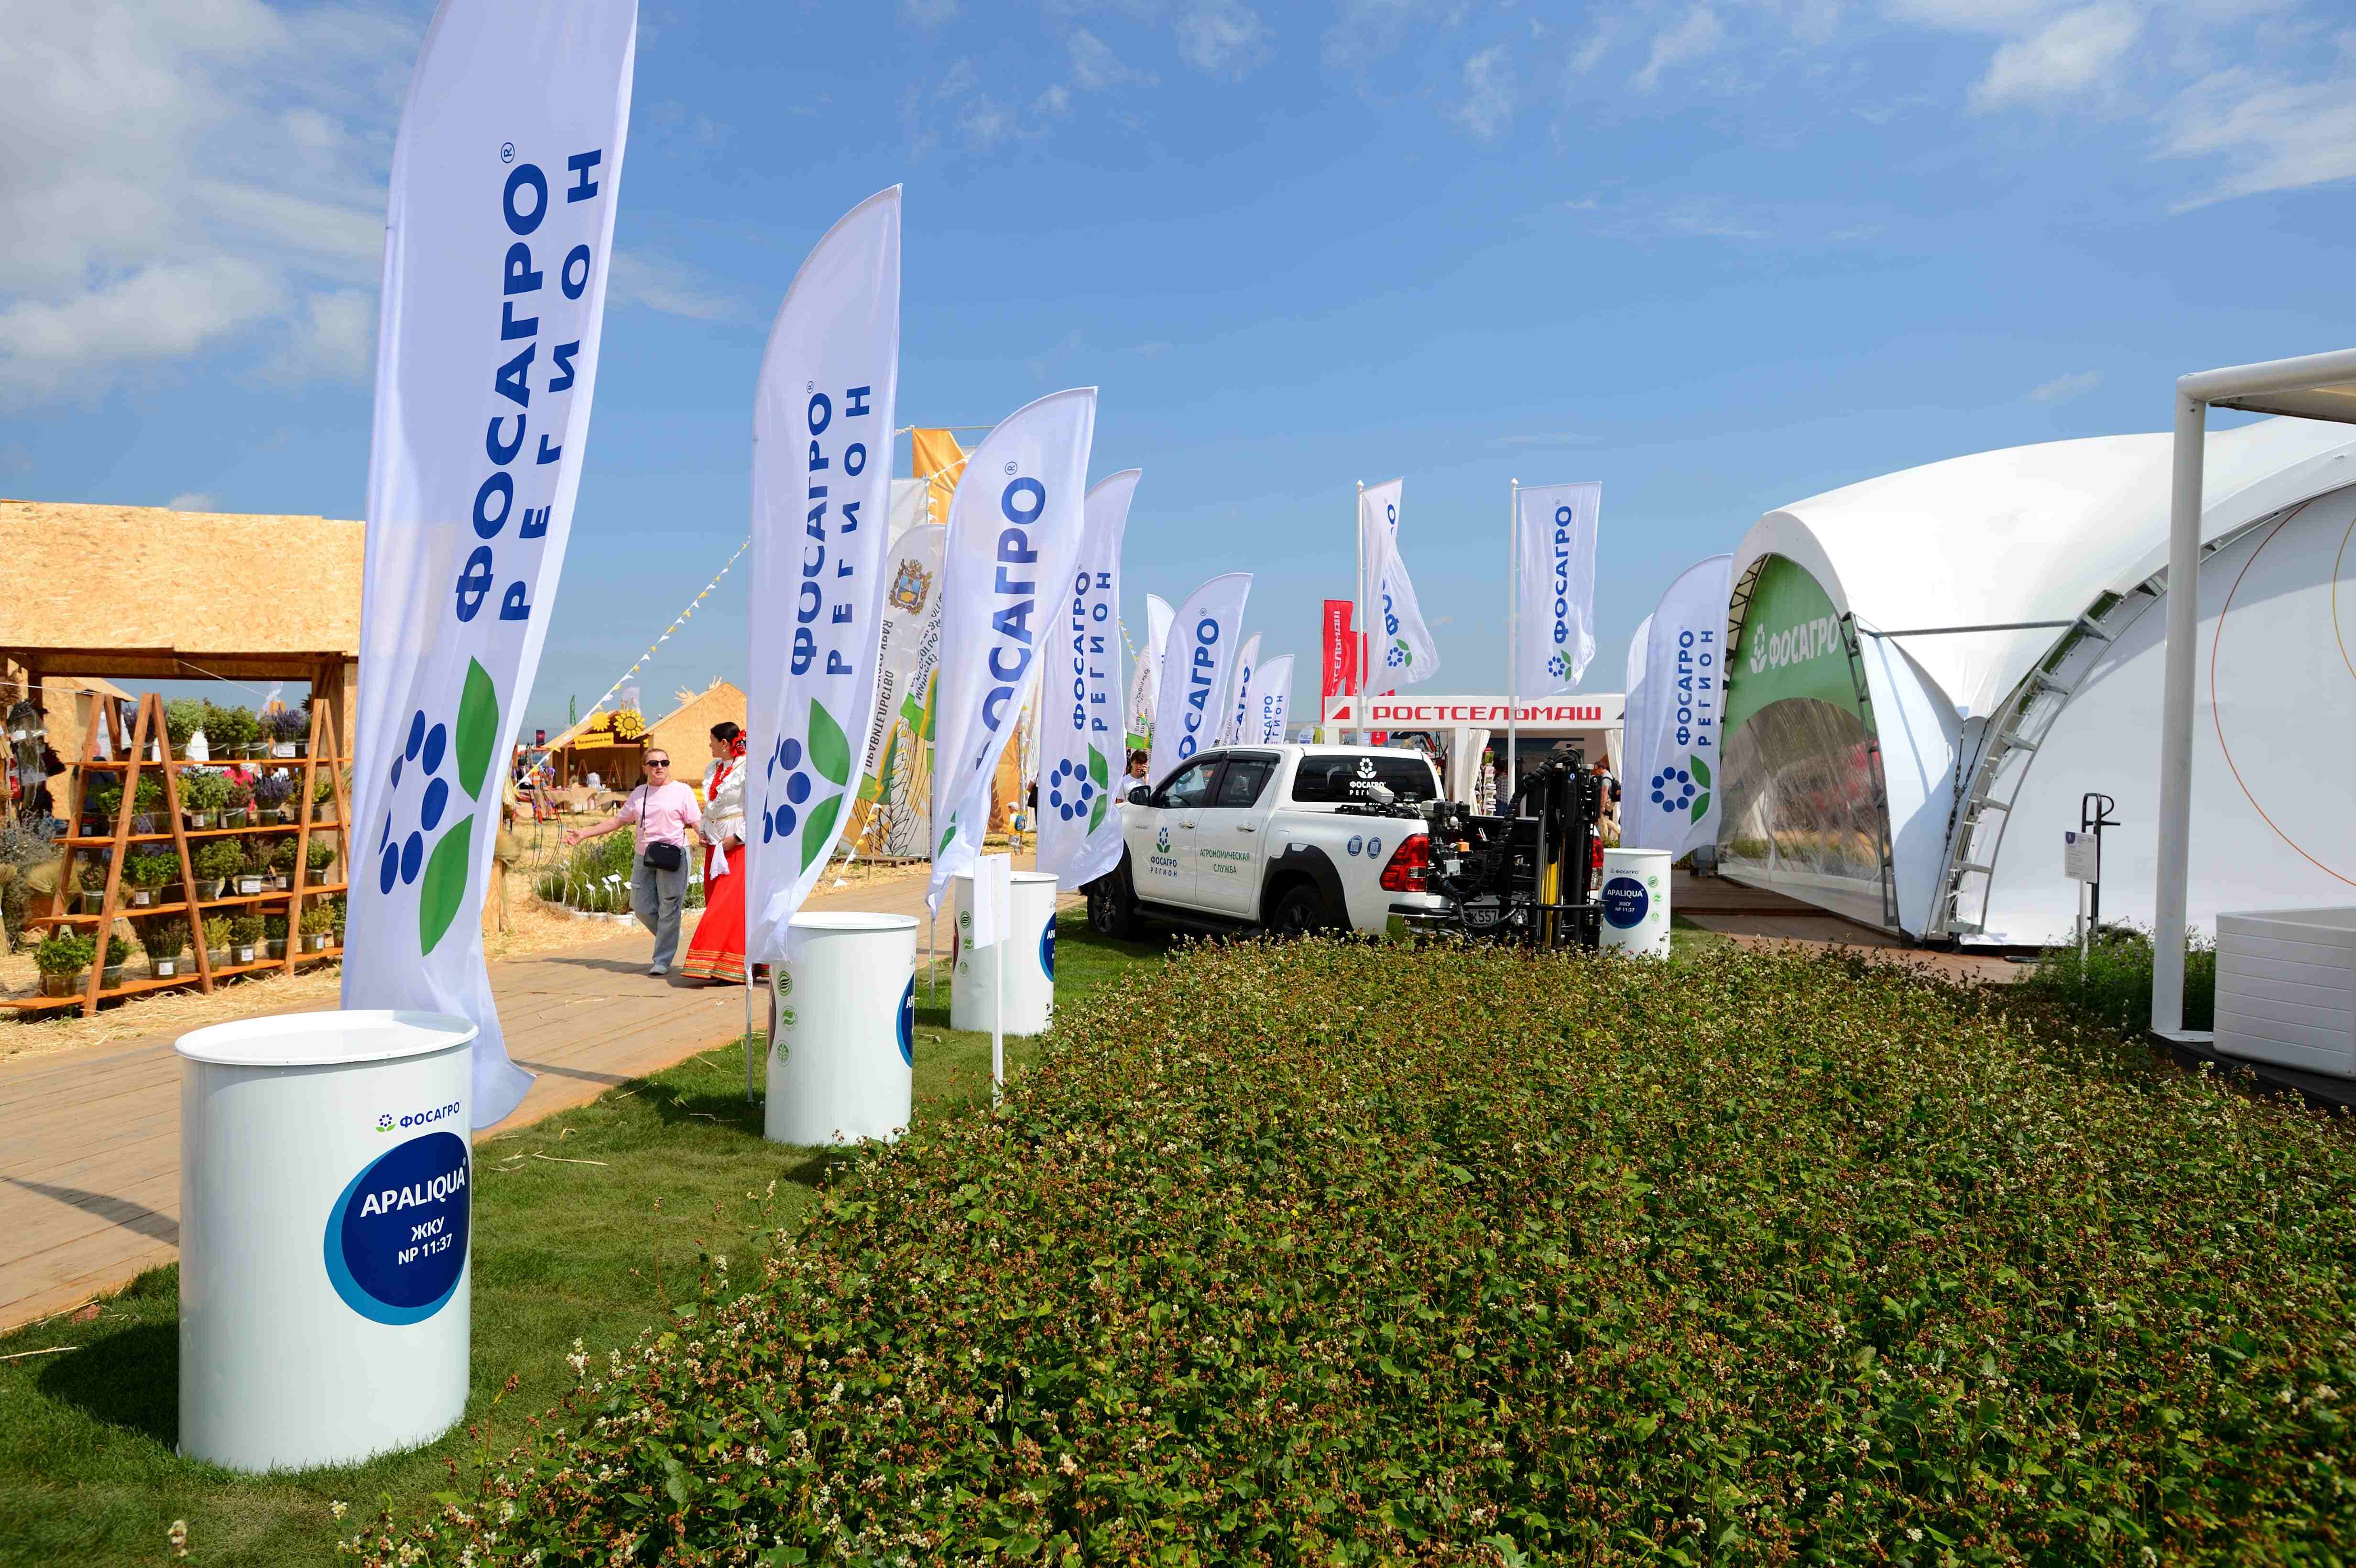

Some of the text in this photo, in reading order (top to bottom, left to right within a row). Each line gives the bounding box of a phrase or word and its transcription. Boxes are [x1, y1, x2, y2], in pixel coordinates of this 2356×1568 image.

[499, 149, 602, 621] РЕГИОН
[826, 386, 871, 675] РЕГИОН
[1090, 572, 1111, 731] РЕГИОН
[1769, 612, 1840, 670] ФОСАГРО
[1698, 631, 1713, 746] РЕГИОН
[1373, 706, 1602, 720] РОСТСЕЛЬМАШ
[1150, 856, 1178, 868] ФОСАГРО
[1200, 849, 1250, 861] АГРОНОМИЧЕСКАЯ
[1213, 864, 1238, 874] СЛУЖБА
[1150, 867, 1178, 878] РЕГИОН
[399, 1100, 461, 1128] ФОСАГРО
[411, 1216, 445, 1242] ЖКУ
[398, 1233, 453, 1265] NP 11:37
